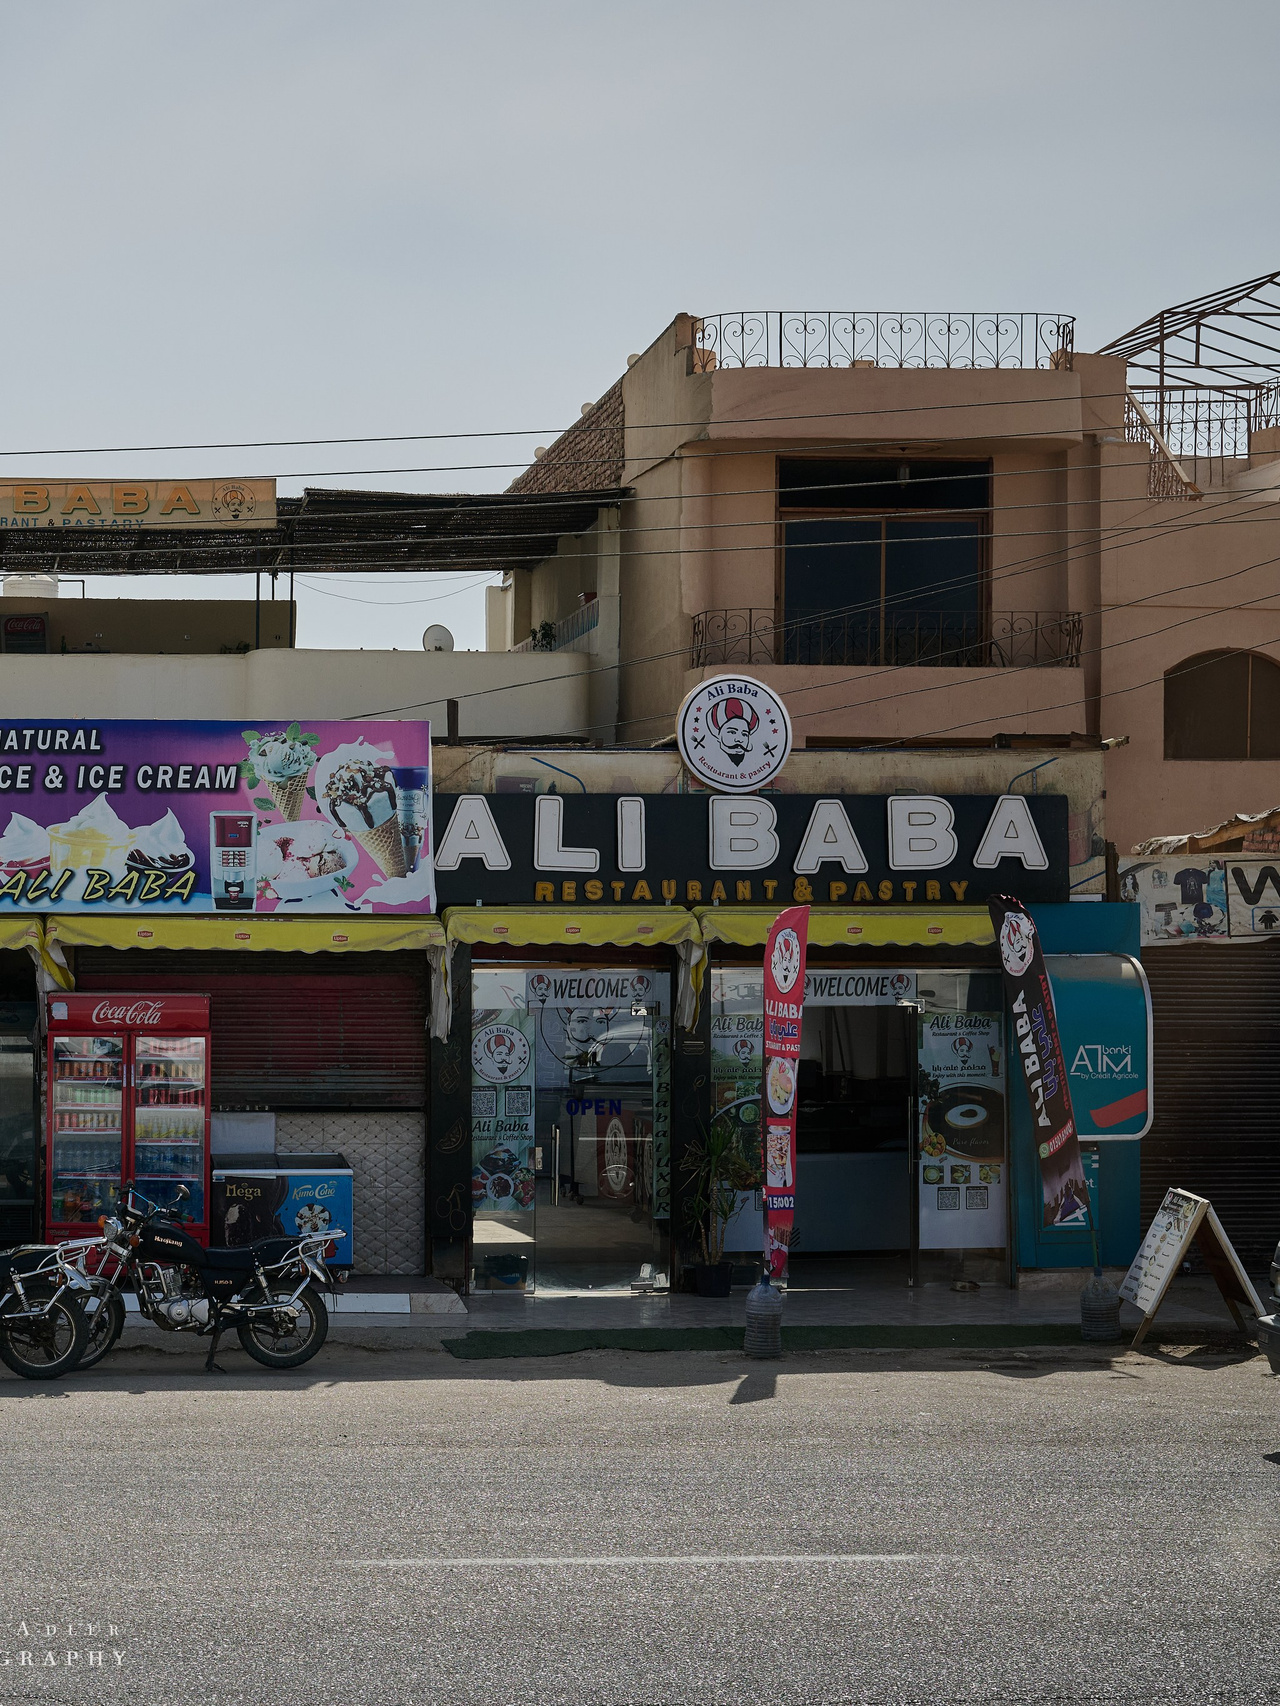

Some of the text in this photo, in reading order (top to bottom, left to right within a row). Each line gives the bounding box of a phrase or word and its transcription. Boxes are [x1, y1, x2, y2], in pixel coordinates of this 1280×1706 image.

[13, 486, 201, 515] BABA
[48, 518, 55, 527] &
[63, 518, 144, 528] PASTARY
[707, 684, 759, 701] Ali Baba
[44, 765, 64, 789] &
[76, 764, 125, 789] ICE
[136, 764, 239, 789] CREAM
[748, 761, 772, 780] pastry
[434, 794, 1050, 874] ALI BABA
[82, 869, 197, 901] BABA
[534, 876, 969, 903] RESTAURANT & PASTRY
[138, 930, 153, 938] Lipton
[553, 977, 630, 999] WELCOME
[813, 974, 890, 998] WELCOME
[92, 1000, 166, 1025] Coca-Cola
[712, 1017, 764, 1031] Ali Bab
[929, 1015, 992, 1030] Ali Baba
[483, 1027, 515, 1038] Ali Baba
[1012, 989, 1040, 1073] BABA
[1029, 1073, 1052, 1127] ALI
[1102, 1044, 1132, 1055] banki
[1070, 1044, 1132, 1073] ATM
[1080, 1072, 1090, 1080] by
[1112, 1072, 1139, 1080] Agricole
[566, 1098, 622, 1116] OPEN
[472, 1120, 529, 1133] Ali Baba
[225, 1184, 262, 1201] Mega
[291, 1184, 315, 1201] Kimo
[154, 1235, 183, 1248] Haojiang
